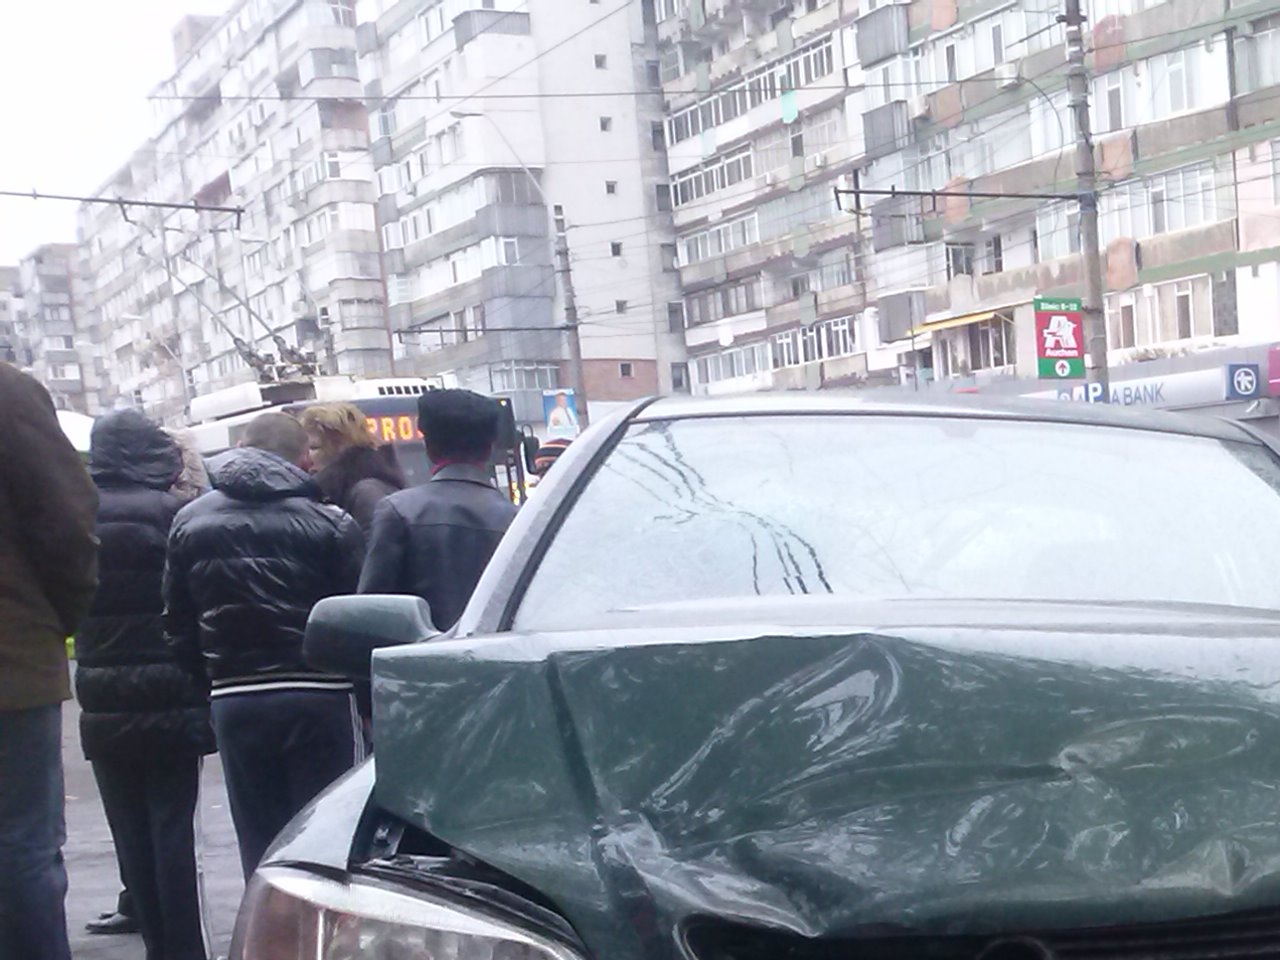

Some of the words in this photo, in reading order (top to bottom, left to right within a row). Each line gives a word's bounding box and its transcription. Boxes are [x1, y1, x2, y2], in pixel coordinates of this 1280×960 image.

[1045, 348, 1079, 357] Auchan
[1123, 382, 1166, 406] BANK
[366, 415, 424, 442] PRO
